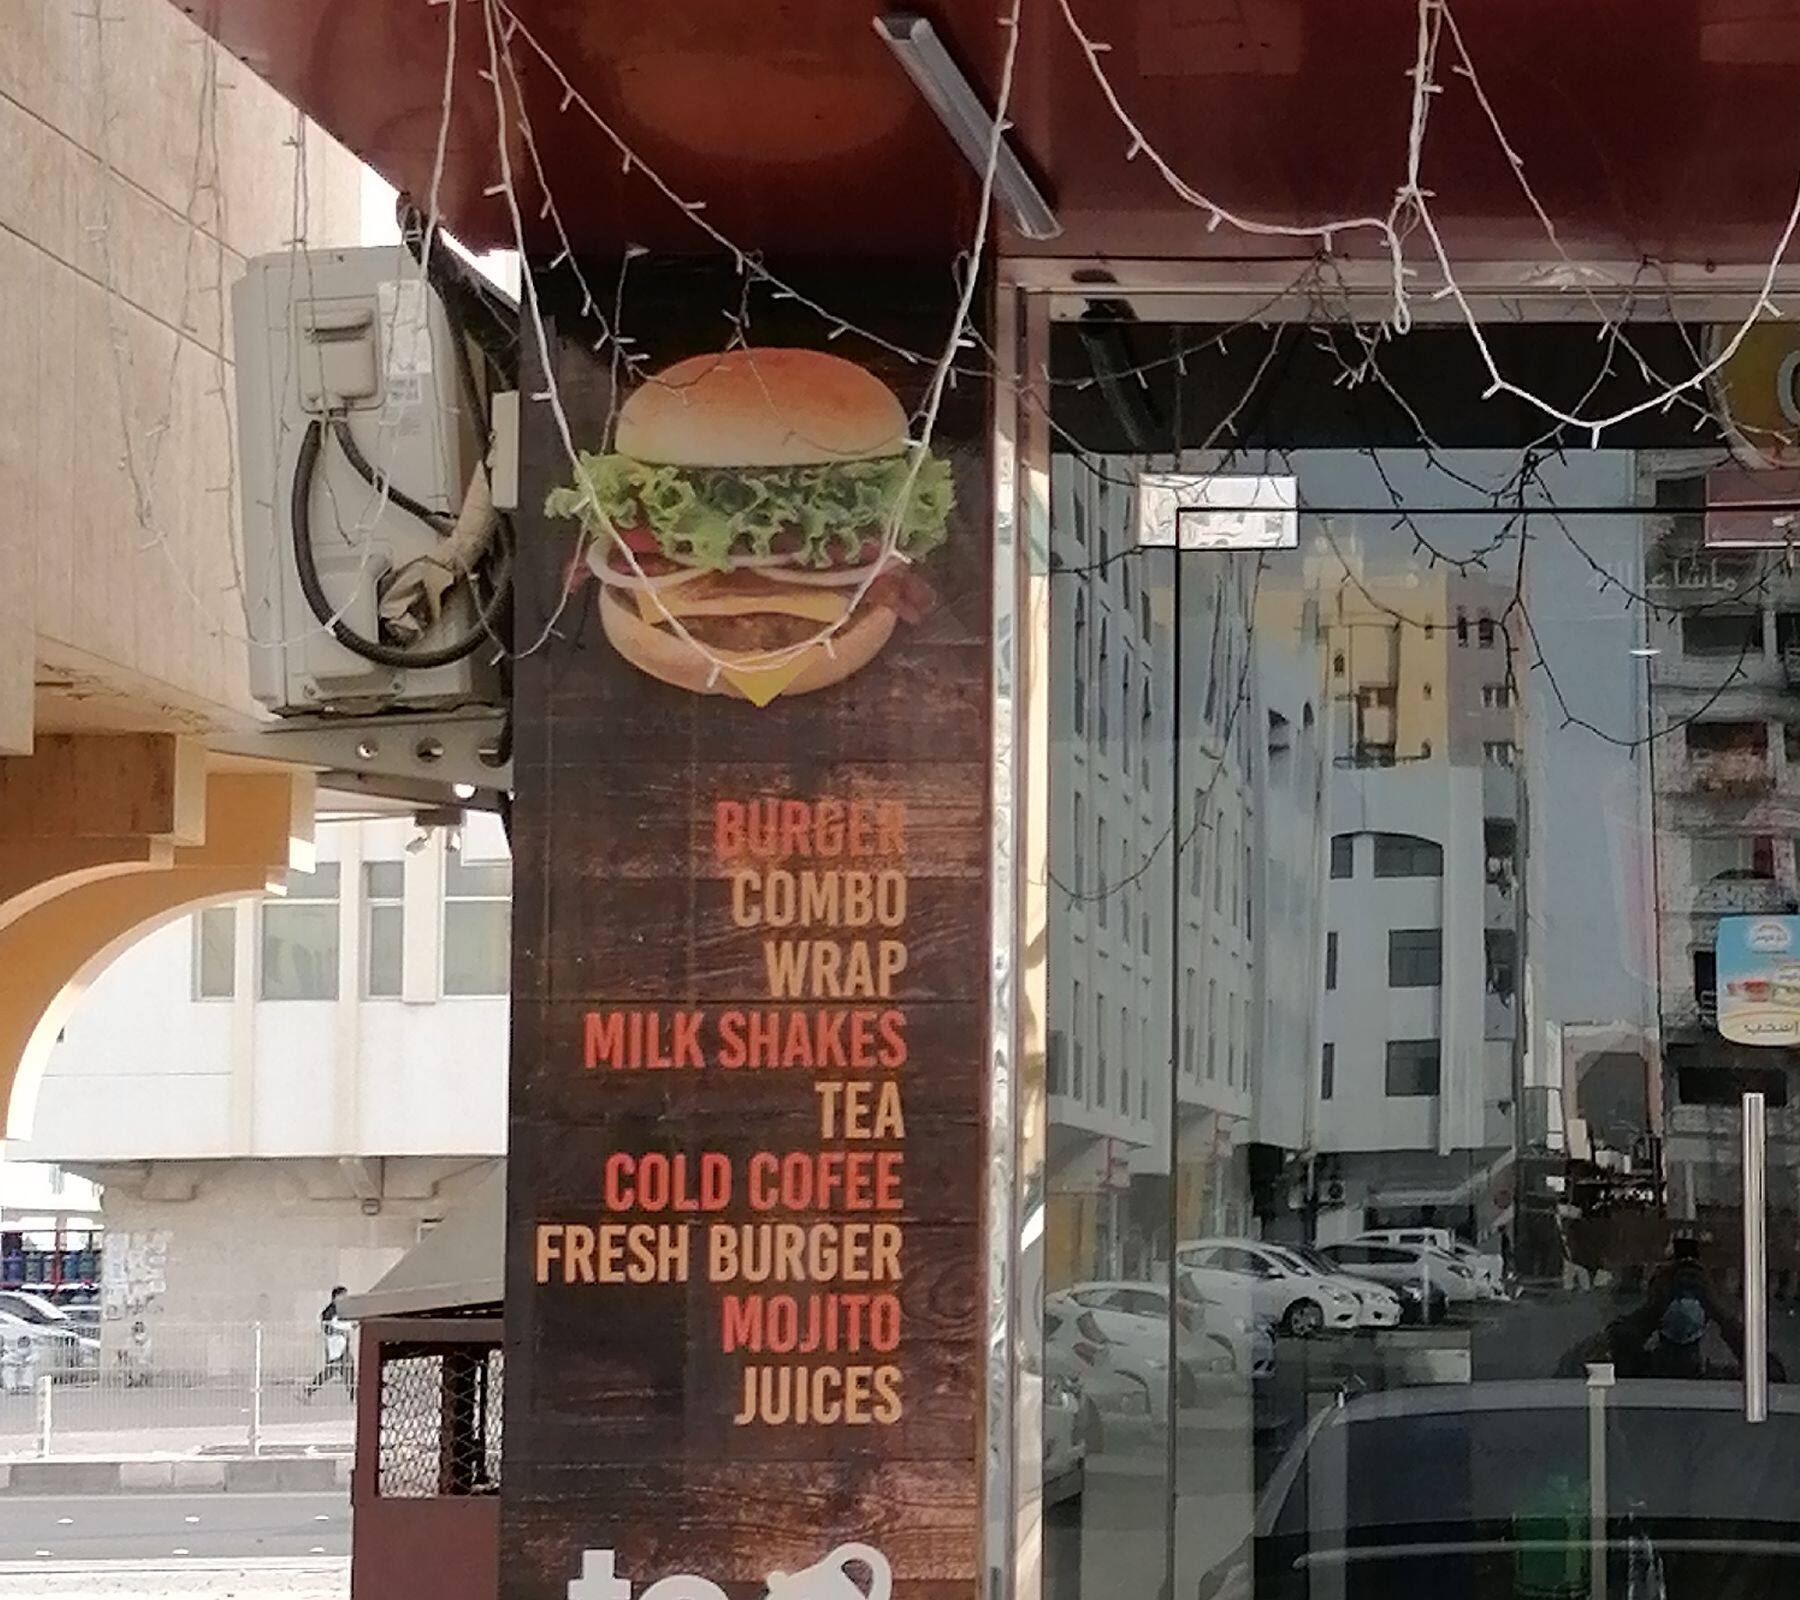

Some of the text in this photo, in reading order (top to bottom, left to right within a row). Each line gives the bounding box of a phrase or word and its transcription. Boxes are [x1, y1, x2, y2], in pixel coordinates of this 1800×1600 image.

[714, 801, 908, 857] BURGER
[731, 870, 907, 929] COMBO
[764, 941, 907, 998] WRAP
[585, 1010, 908, 1070] MILK SHAKES
[815, 1082, 905, 1140] TEA
[604, 1152, 904, 1212] COLD COFEE
[536, 1223, 903, 1284] FRESH BURGER
[721, 1295, 902, 1353] MOJITO
[734, 1366, 903, 1427] JUICES
